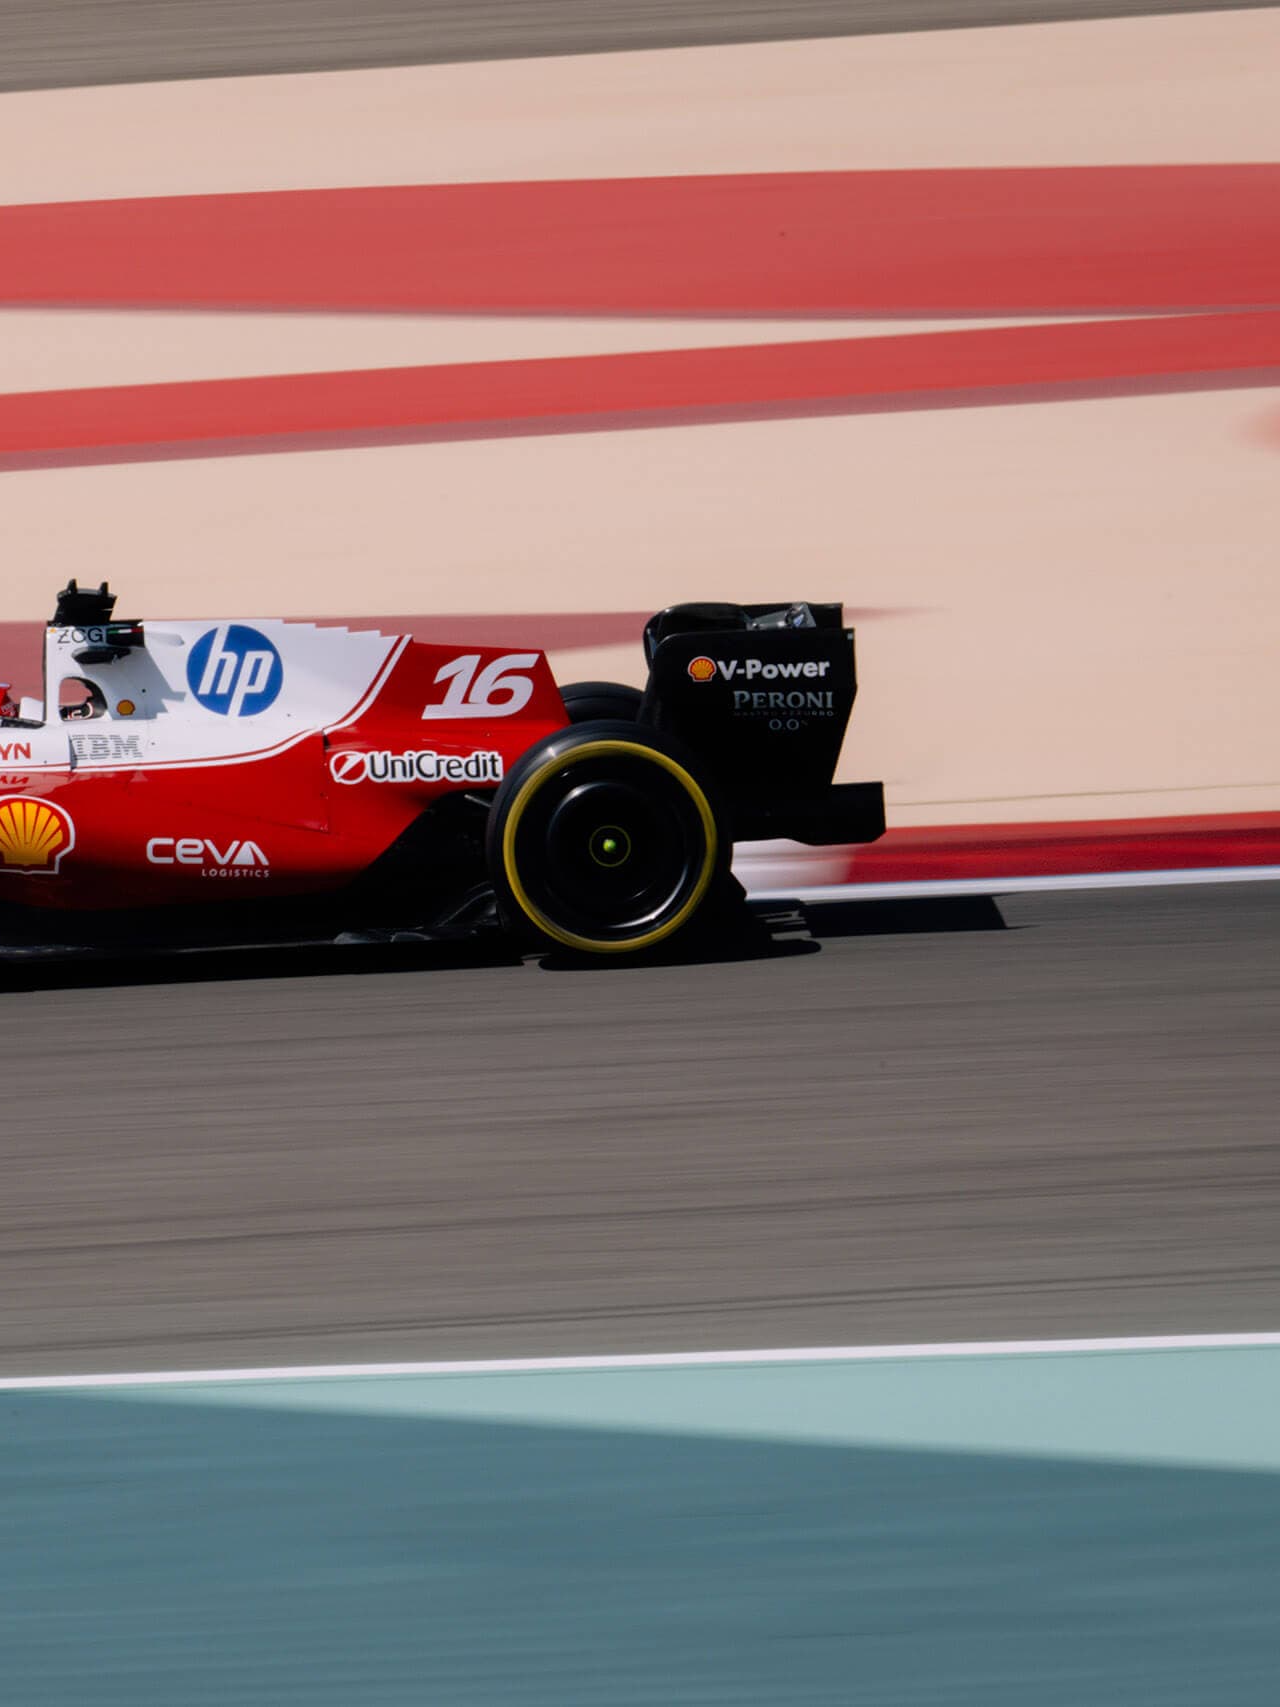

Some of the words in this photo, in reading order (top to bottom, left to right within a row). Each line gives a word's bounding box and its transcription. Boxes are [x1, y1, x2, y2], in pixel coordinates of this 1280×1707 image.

[198, 625, 274, 717] hp
[717, 659, 830, 680] V-Power
[421, 653, 539, 720] 16
[733, 690, 833, 709] PERONI
[72, 734, 144, 760] IBM
[369, 753, 500, 779] UniCredit
[202, 868, 269, 878] LOGISTICS
